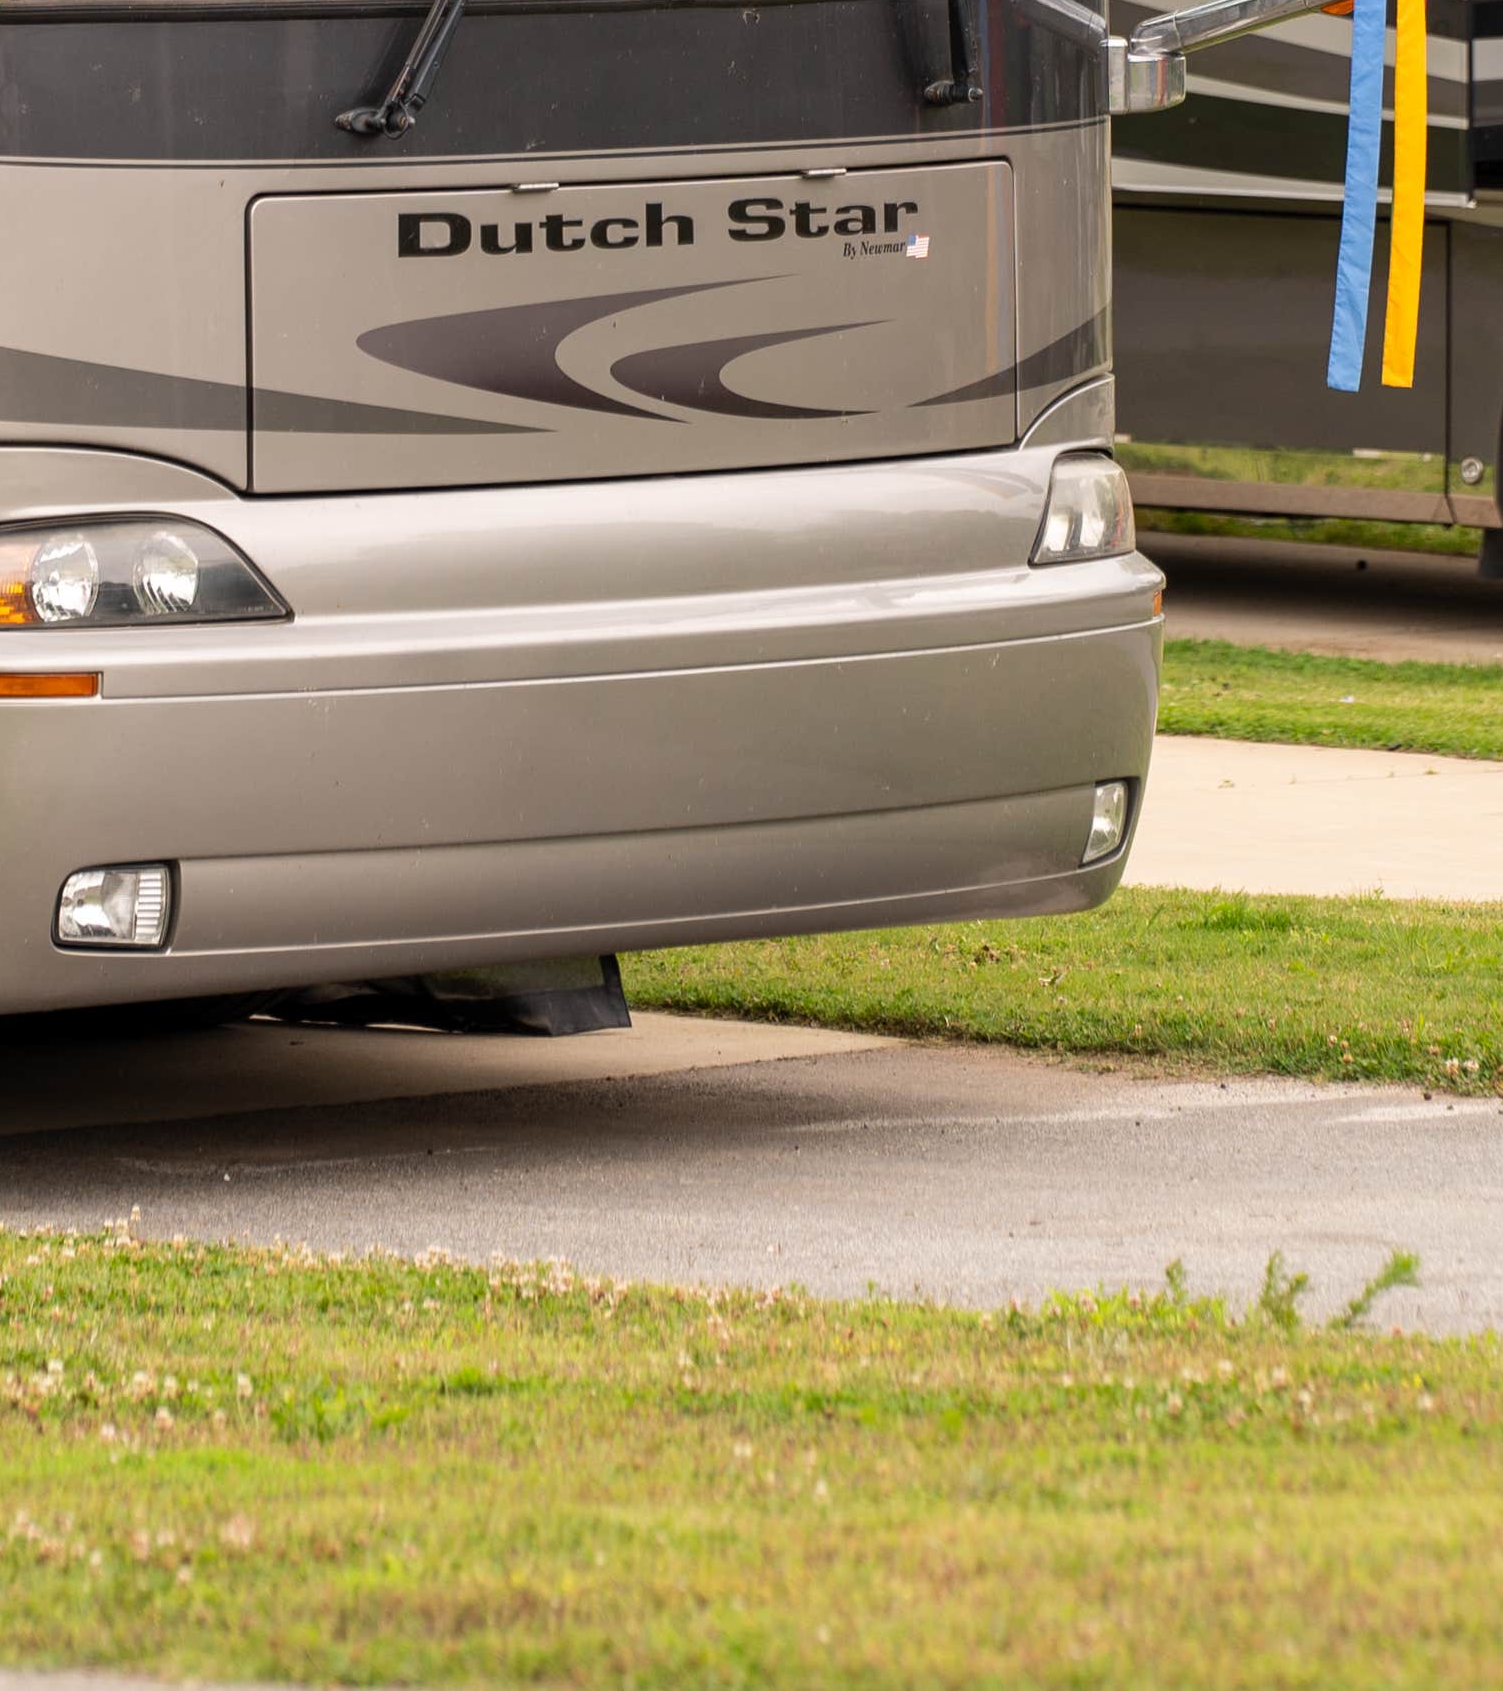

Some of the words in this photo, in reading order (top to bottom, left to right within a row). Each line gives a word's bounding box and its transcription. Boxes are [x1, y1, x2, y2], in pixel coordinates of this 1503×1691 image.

[398, 202, 694, 258] Dutch
[728, 197, 919, 242] Star
[843, 241, 856, 260] By
[860, 240, 906, 256] Newmar
